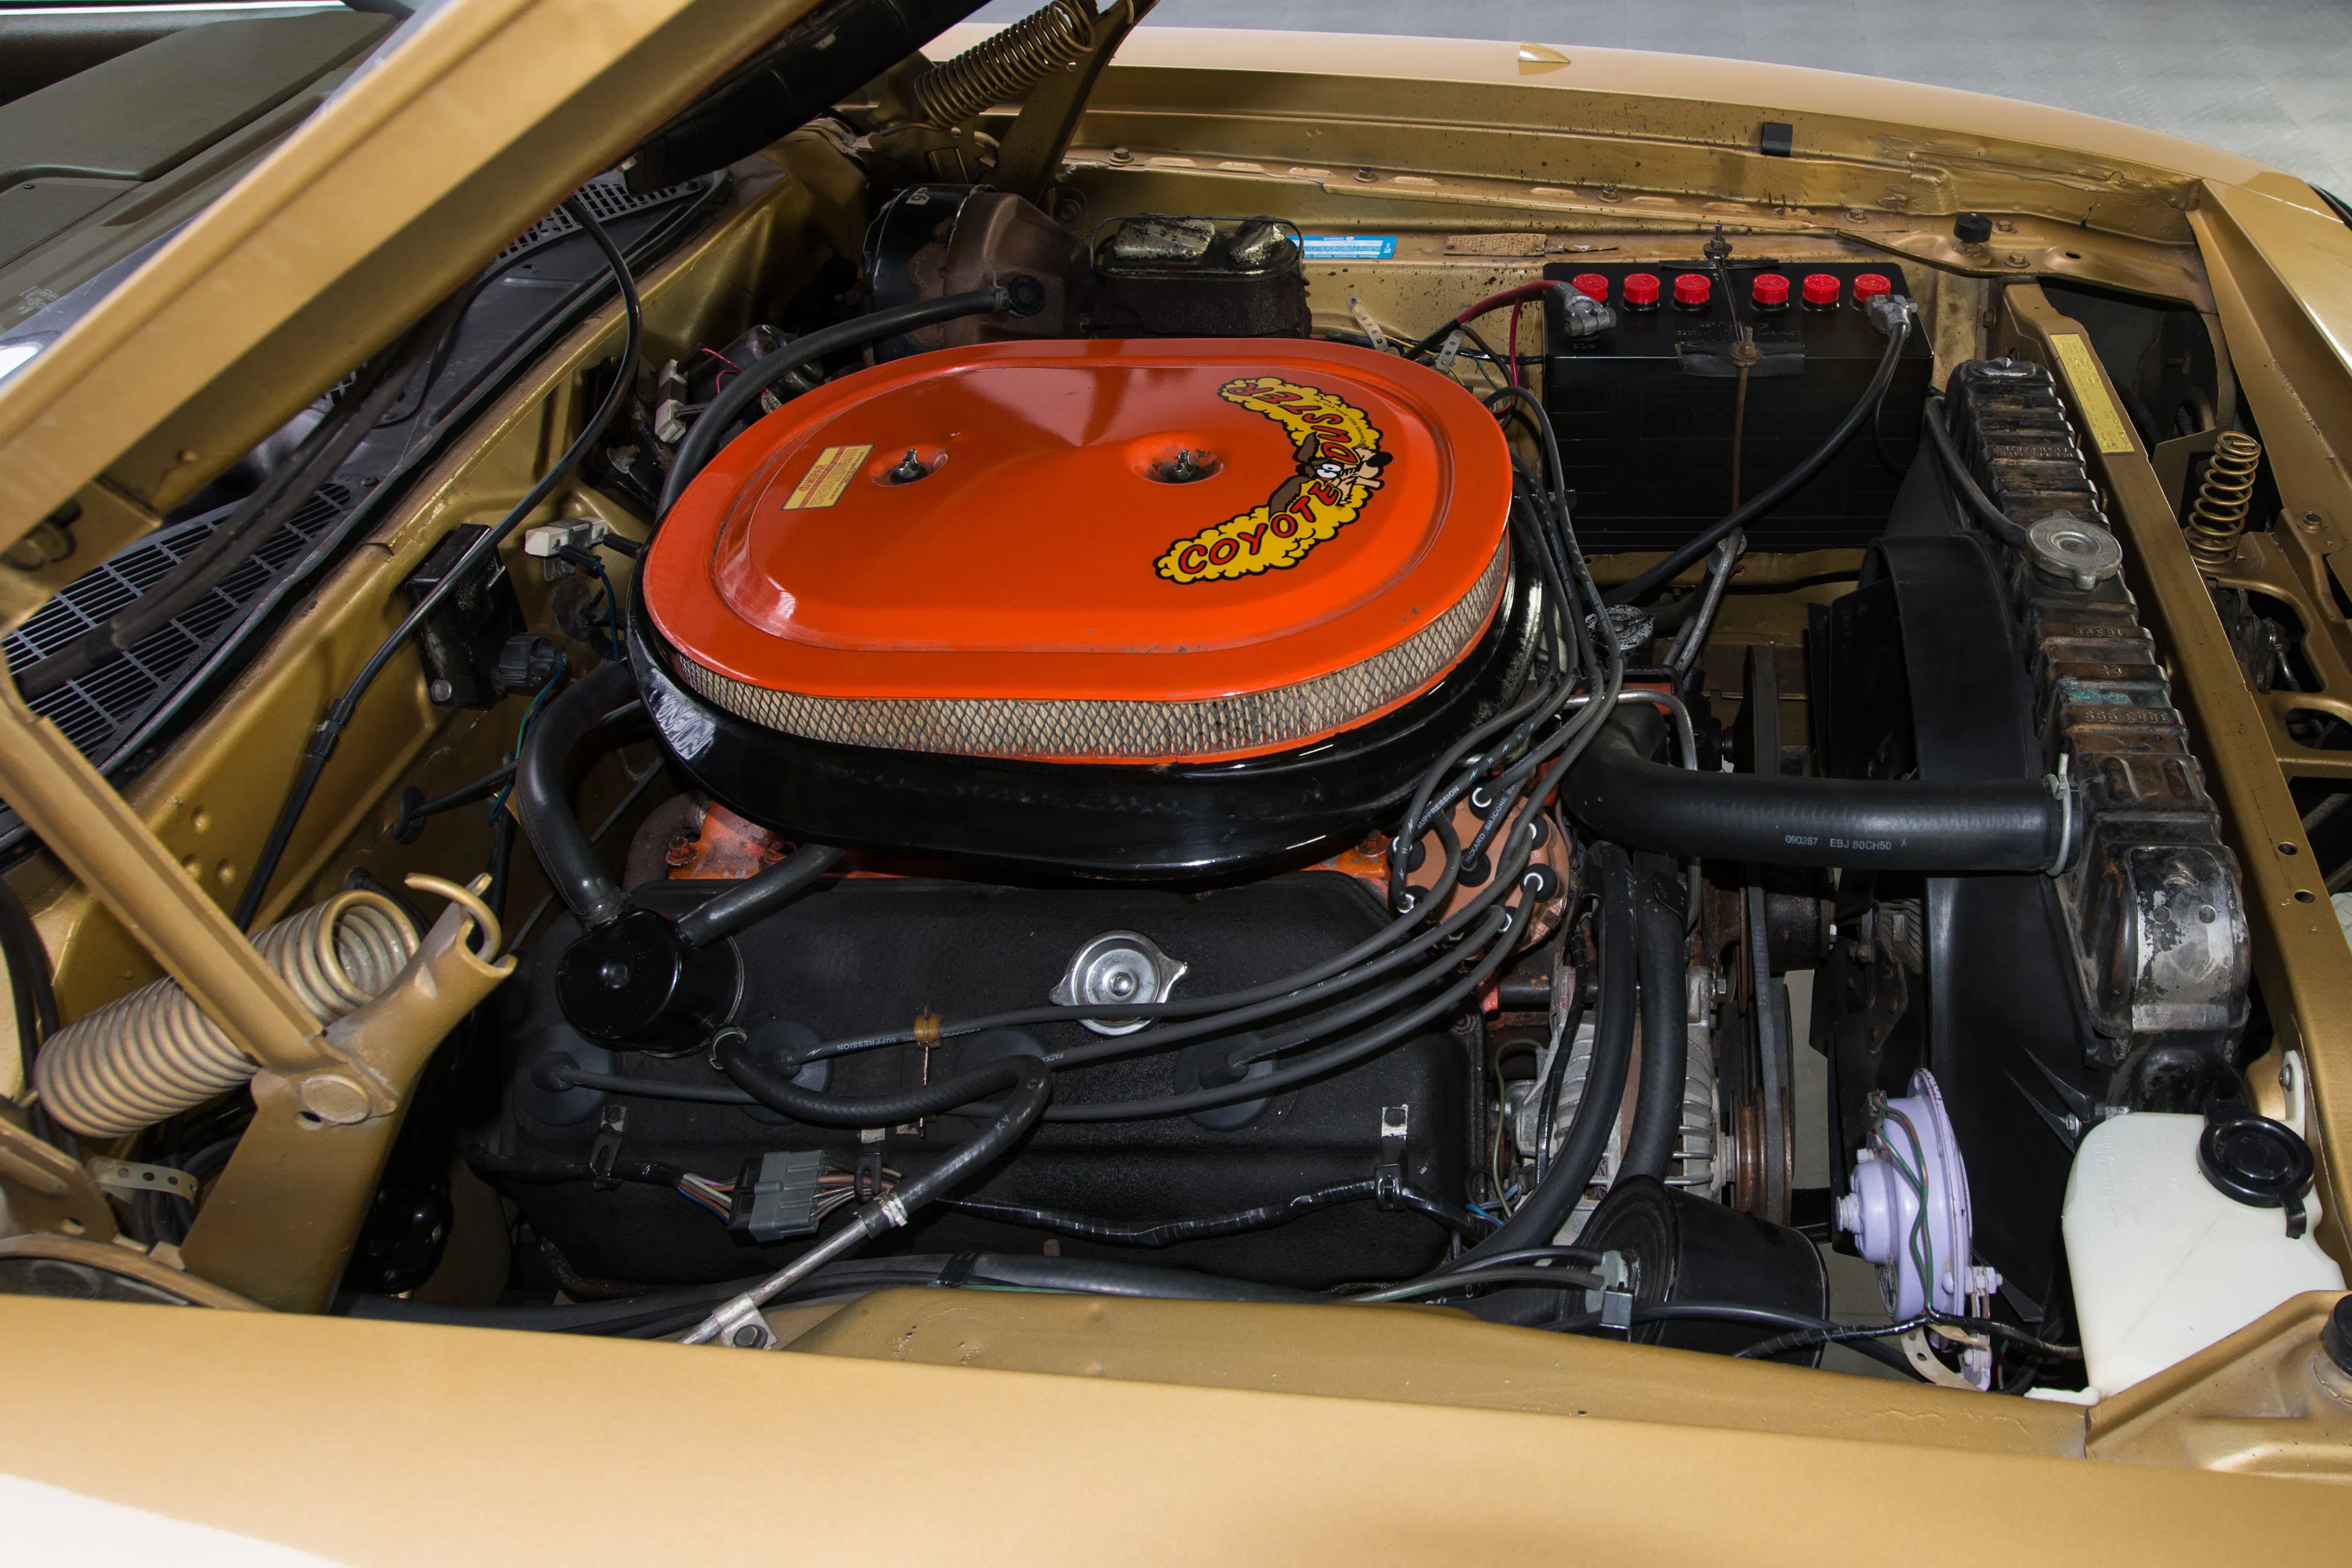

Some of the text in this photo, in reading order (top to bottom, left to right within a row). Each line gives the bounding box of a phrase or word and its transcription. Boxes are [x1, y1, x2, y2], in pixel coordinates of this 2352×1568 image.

[1227, 382, 1359, 466] DUSTER
[805, 464, 827, 486] MOPAR
[1178, 480, 1341, 575] COYOTE
[1417, 785, 1460, 830] SUPPRESSION
[1466, 796, 1508, 864] PACKARD SILICONE
[1785, 834, 1819, 846] 090287
[1830, 837, 1850, 849] EBJ
[837, 1036, 897, 1051] SUPPRESSION
[1042, 1050, 1065, 1063] PACKA
